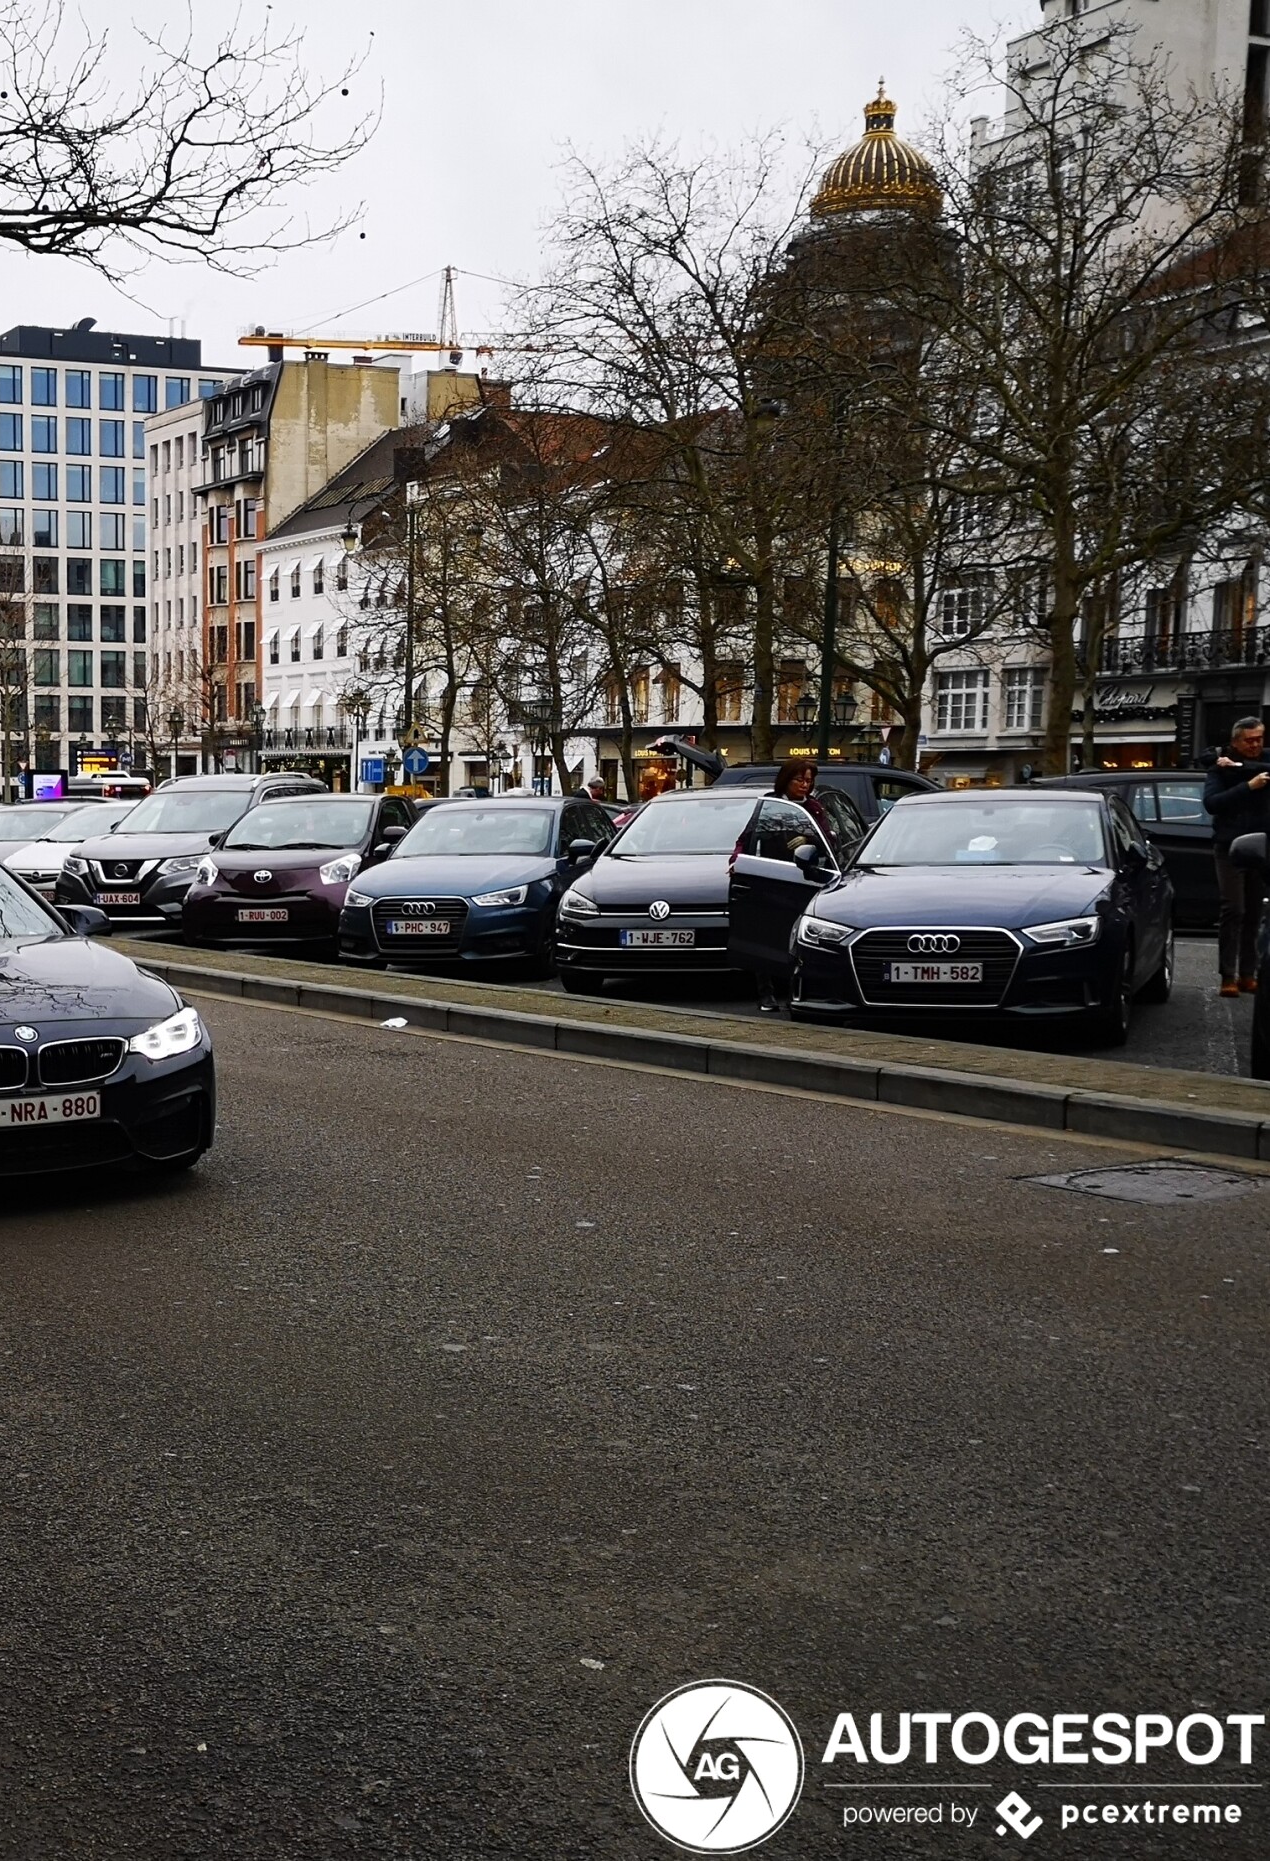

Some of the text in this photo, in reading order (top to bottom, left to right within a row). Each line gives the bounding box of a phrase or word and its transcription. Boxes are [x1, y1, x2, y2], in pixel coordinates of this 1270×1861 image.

[789, 747, 810, 756] LOUIS
[97, 894, 139, 904] 1-UAX-604
[240, 911, 287, 920] 1-RUU-002
[394, 922, 449, 933] 1-PHC-947
[629, 932, 693, 944] 1-WJE-762
[894, 966, 980, 980] 1-TMH-582
